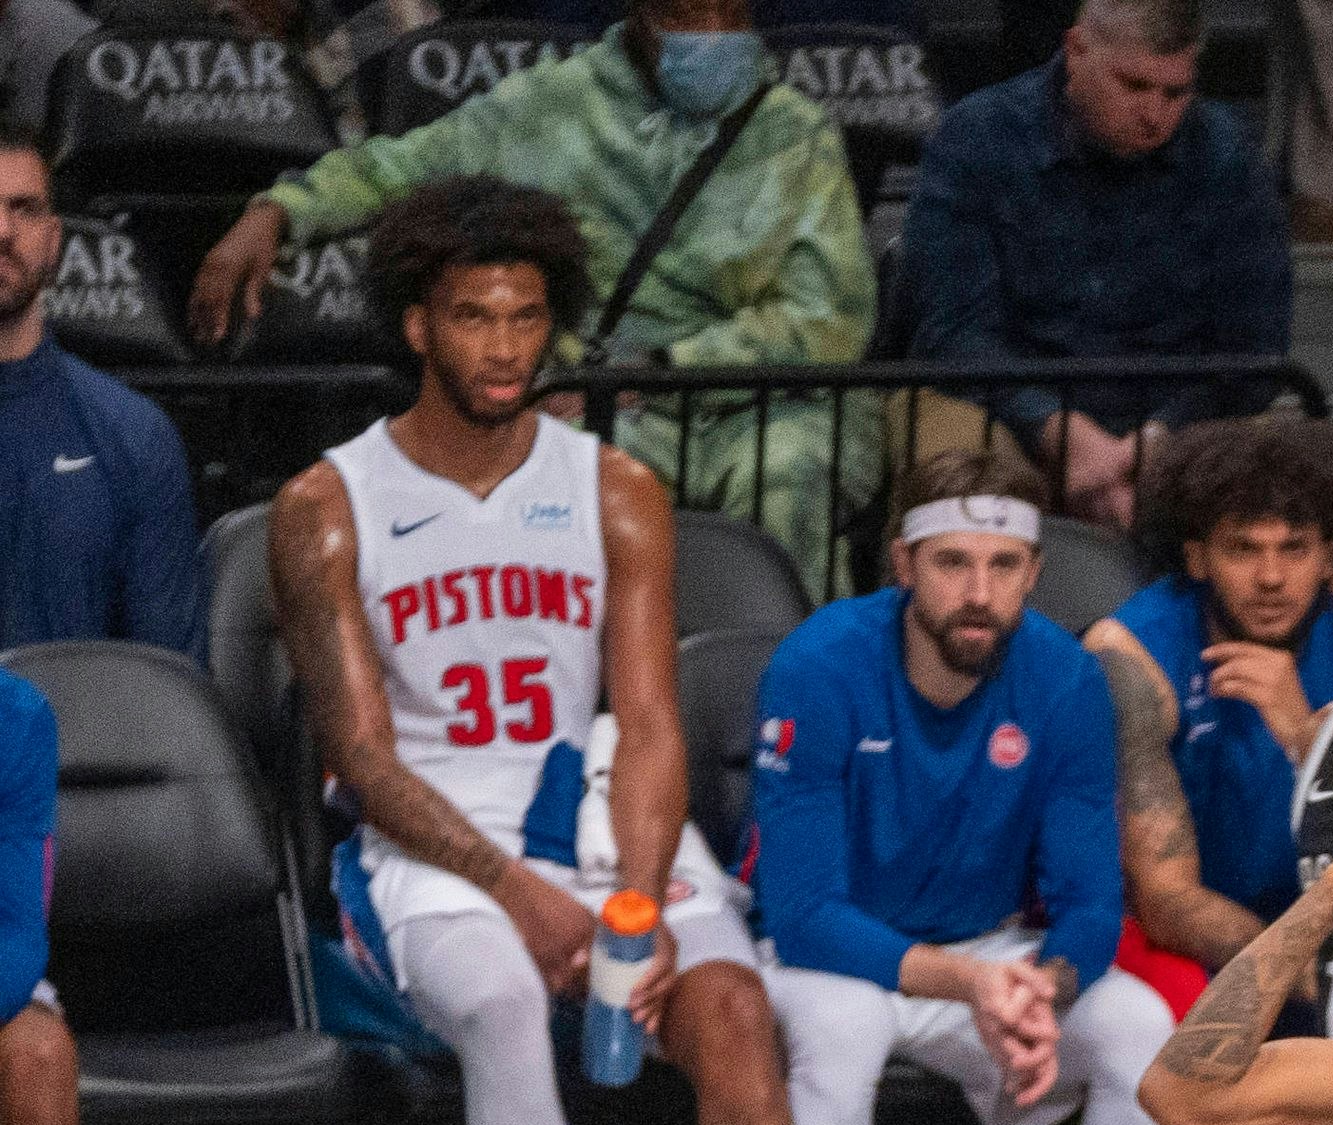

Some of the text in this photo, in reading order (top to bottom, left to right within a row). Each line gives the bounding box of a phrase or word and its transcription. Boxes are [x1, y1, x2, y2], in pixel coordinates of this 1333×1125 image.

[87, 40, 291, 99] QATAR
[764, 43, 932, 95] ATAR
[380, 564, 594, 645] PISTONS
[441, 656, 554, 748] 35
